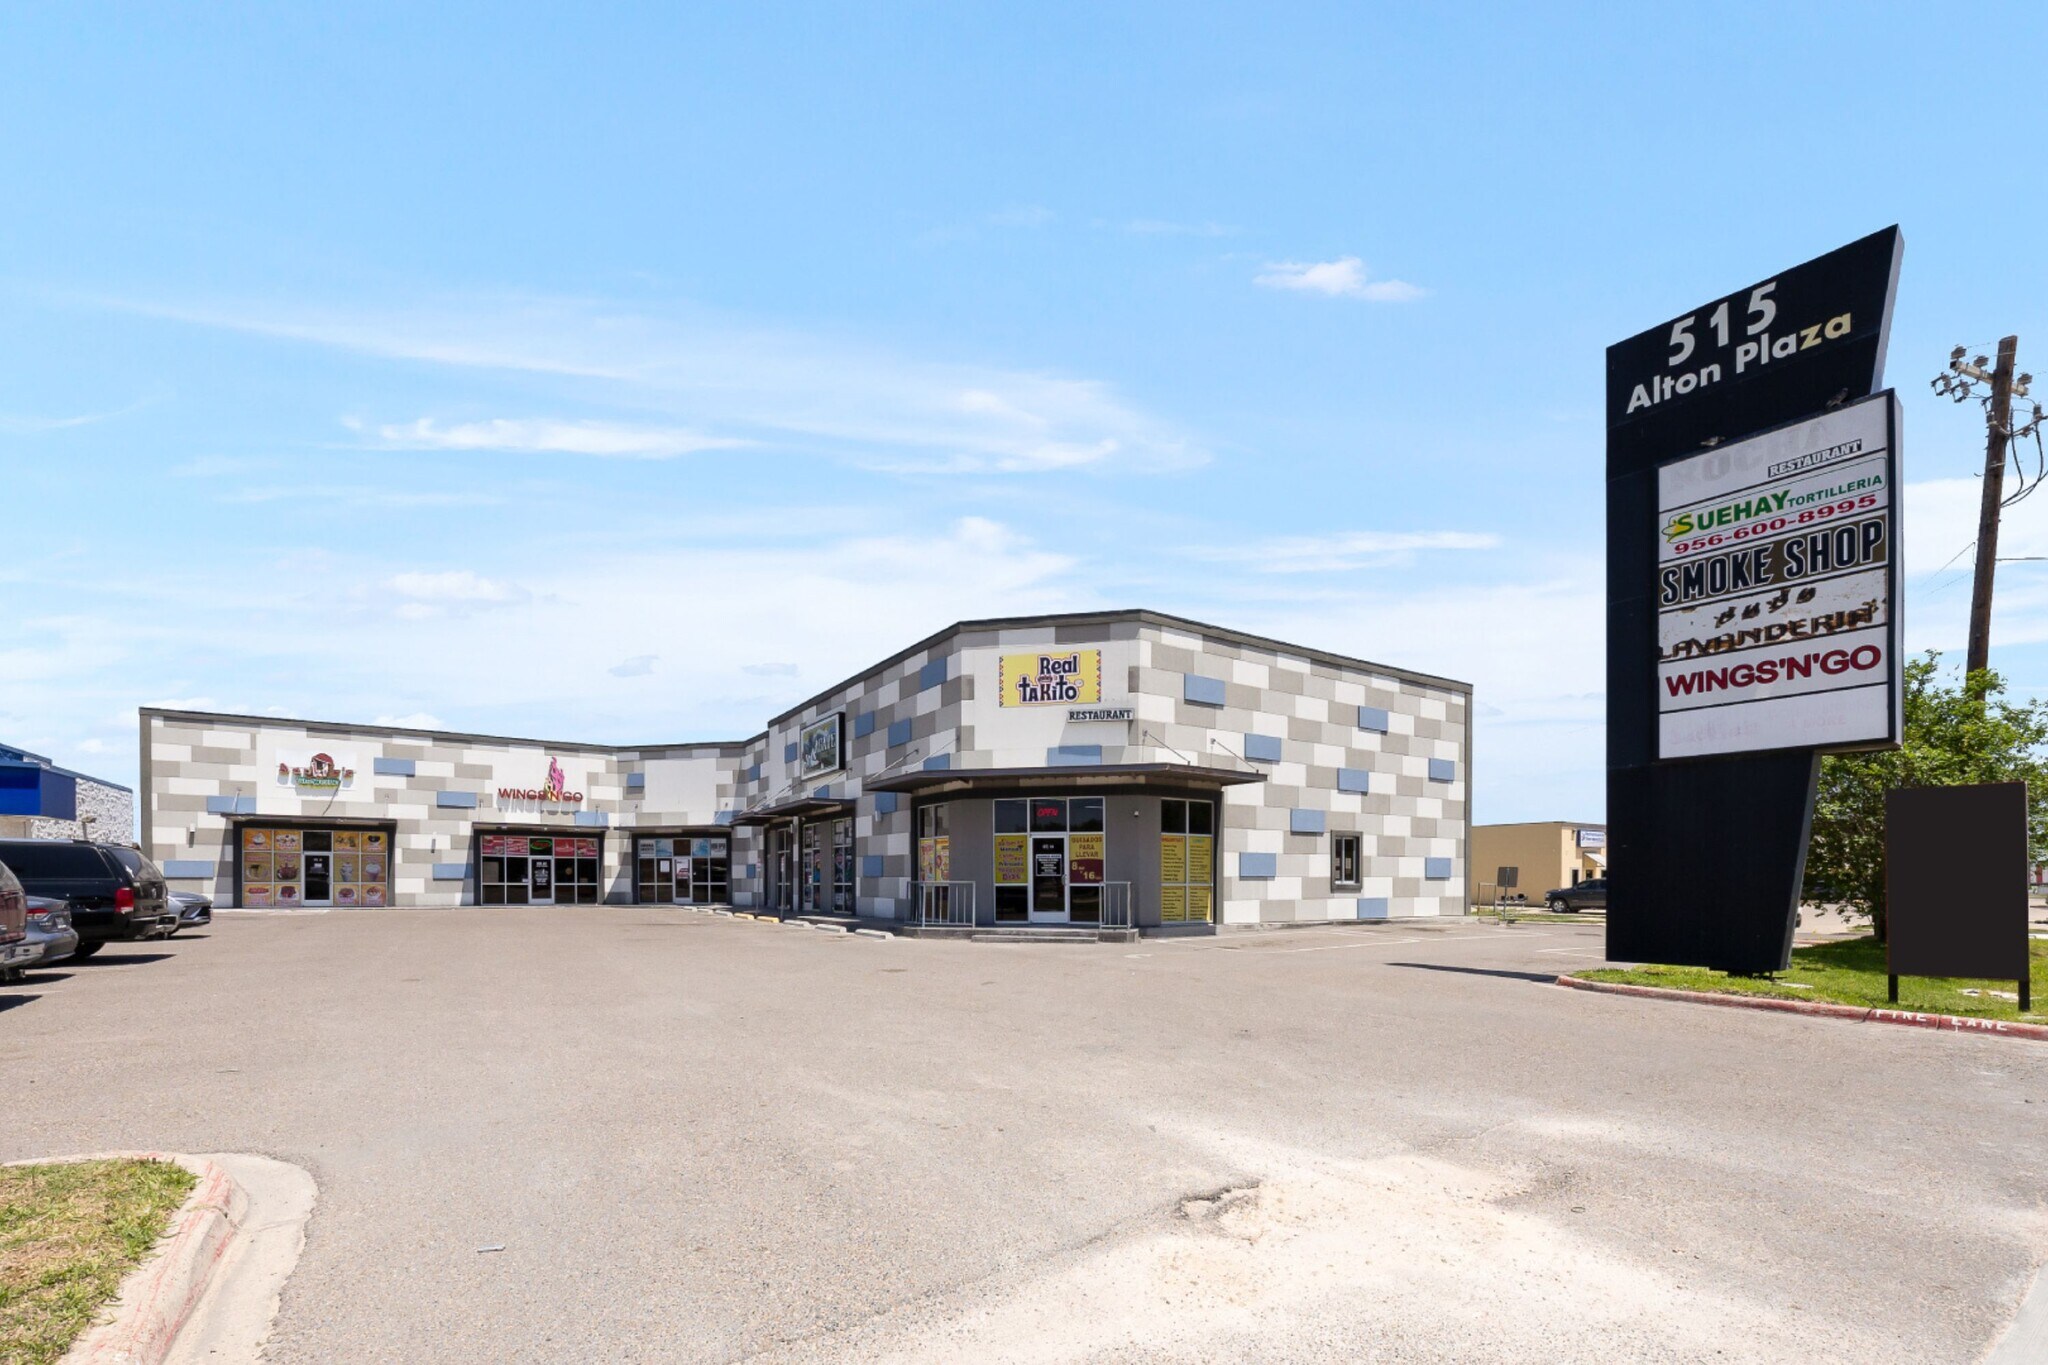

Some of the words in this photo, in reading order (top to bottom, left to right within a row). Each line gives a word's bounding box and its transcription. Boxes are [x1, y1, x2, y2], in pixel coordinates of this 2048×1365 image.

[1668, 281, 1777, 367] 515
[1626, 362, 1721, 414] Alton
[1736, 312, 1851, 374] Plaza
[1768, 439, 1862, 478] RESTAURANT
[1667, 489, 1790, 543] SUEHAY
[1788, 475, 1883, 507] TORTILLERIA
[1674, 494, 1877, 554] 956-600-8995
[1661, 543, 1773, 605] SMOKE
[1784, 517, 1884, 580] SHOP
[1660, 606, 1874, 659] LAVANDERIA
[1039, 655, 1077, 675] Real
[1665, 644, 1882, 697] WINGS'N'GO
[1069, 709, 1132, 721] RESTAURANT
[498, 787, 584, 803] WINGSN'GO
[1071, 861, 1078, 871] 8
[1083, 871, 1095, 880] 16
[1951, 1016, 2008, 1031] LANE
